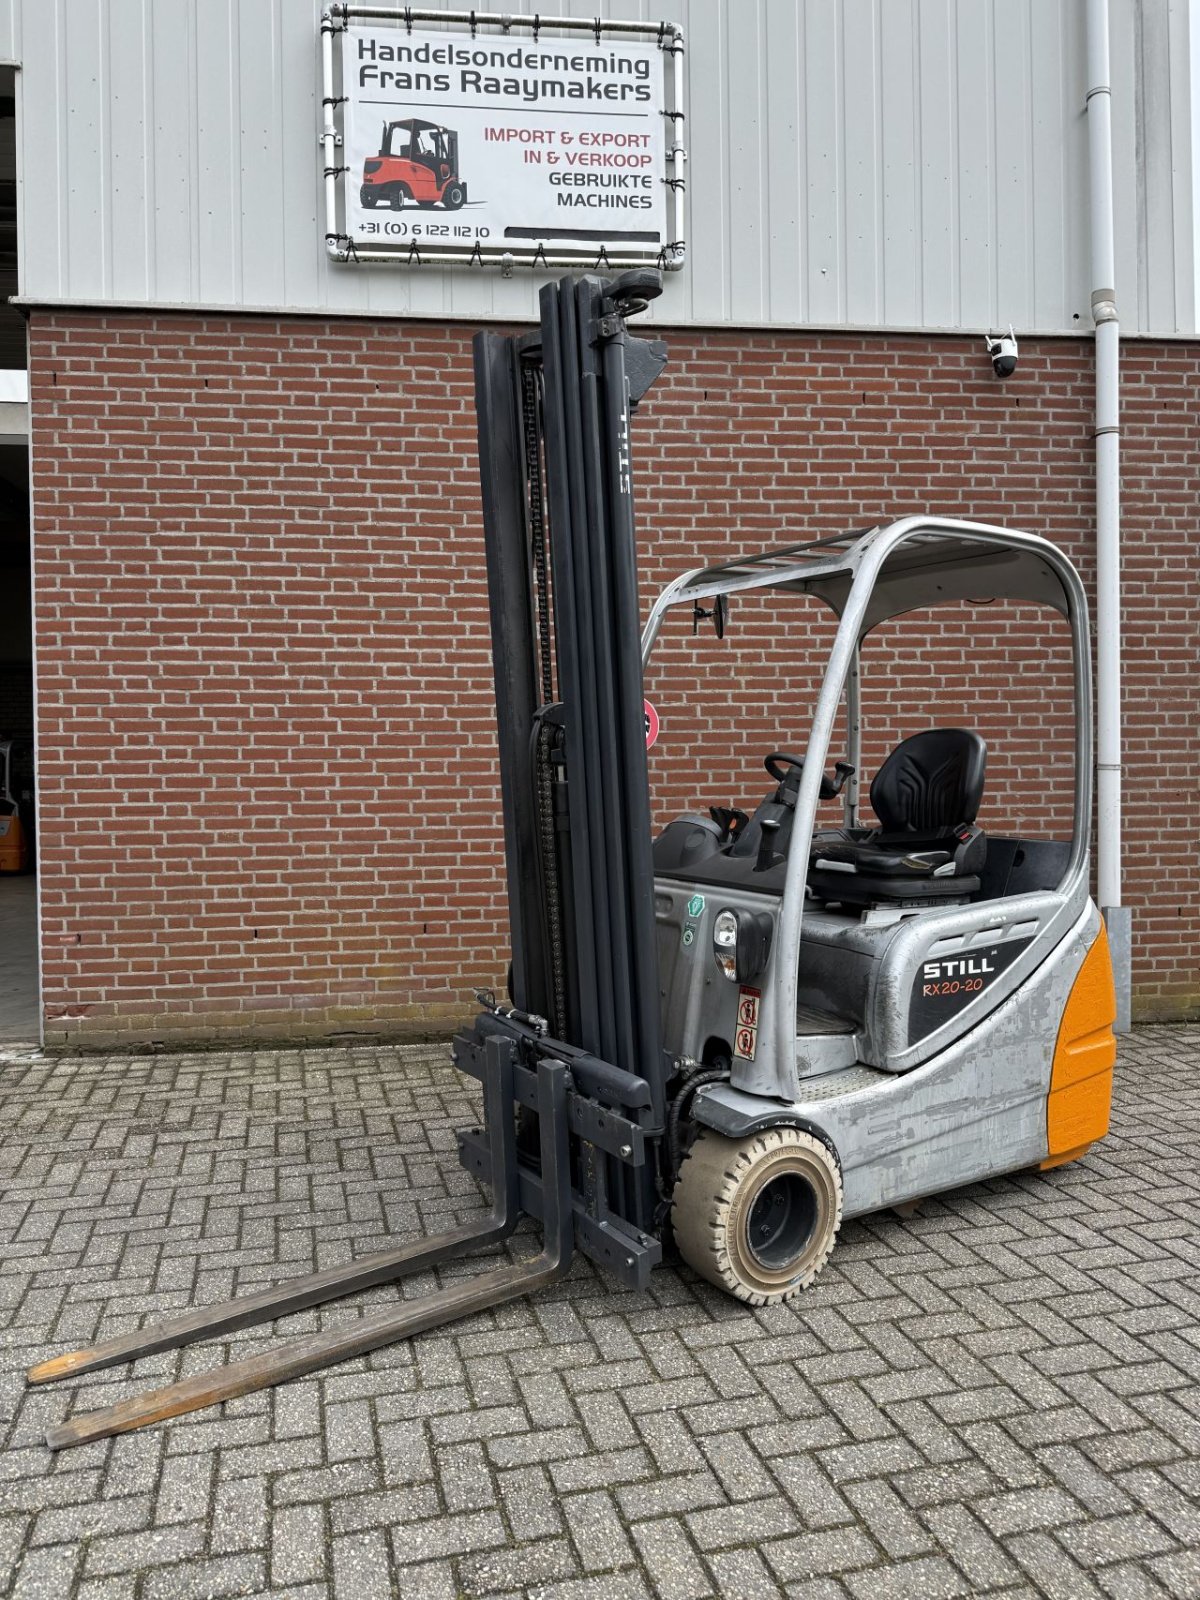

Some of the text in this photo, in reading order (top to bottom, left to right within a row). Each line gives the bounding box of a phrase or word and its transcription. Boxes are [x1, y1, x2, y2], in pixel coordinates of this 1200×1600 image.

[358, 38, 650, 80] Handelsonderneming
[359, 64, 651, 102] Frans Raaymakers
[484, 127, 651, 148] IMPORT & EXPORT
[524, 150, 652, 168] IN & VERKOOP
[548, 171, 652, 189] GEBRUIKTE
[557, 192, 653, 209] MACHINES
[358, 221, 490, 238] +31 (0) 6 122 112 10
[923, 958, 995, 980] STILL
[922, 978, 984, 997] RX20-20
